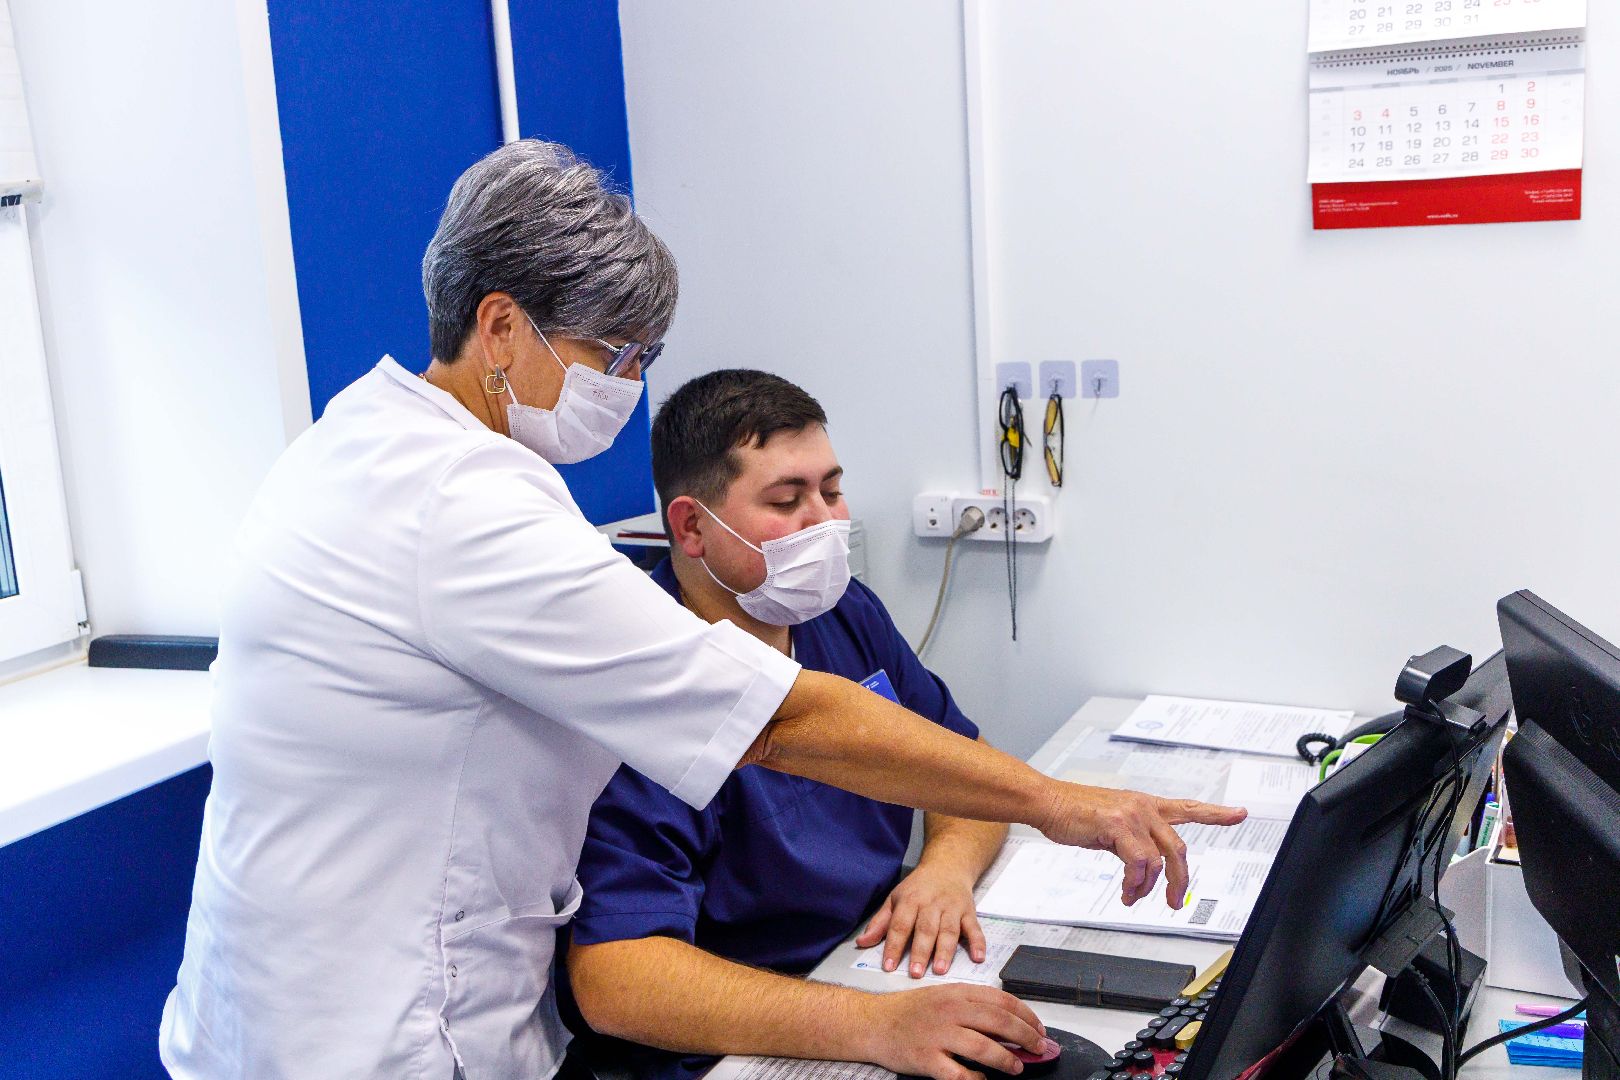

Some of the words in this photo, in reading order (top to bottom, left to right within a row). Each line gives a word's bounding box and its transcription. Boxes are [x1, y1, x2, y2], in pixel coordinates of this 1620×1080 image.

[1349, 8, 1366, 20] 20
[1377, 6, 1392, 17] 21
[1406, 3, 1422, 15] 22
[1434, 0, 1452, 12] 23
[1348, 25, 1365, 36] 27
[1377, 22, 1393, 33] 28
[1405, 20, 1422, 30] 29
[1434, 17, 1451, 27] 30
[1464, 14, 1479, 25] 31
[1387, 67, 1419, 76] НОЯБРЬ
[1434, 65, 1453, 73] 2025
[1467, 60, 1514, 70] NOVEMBER
[1498, 83, 1504, 94] 1
[1527, 81, 1536, 92] 2
[1353, 110, 1362, 121] 3
[1382, 108, 1390, 118] 4
[1409, 106, 1418, 117] 5
[1438, 104, 1447, 115] 6
[1467, 102, 1476, 112] 7
[1497, 100, 1505, 111] 8
[1526, 98, 1535, 109] 9
[1350, 126, 1366, 137] 10
[1379, 124, 1392, 135] 11
[1407, 122, 1422, 133] 12
[1435, 120, 1451, 131] 13
[1464, 118, 1479, 129] 14
[1493, 116, 1510, 128] 15
[1523, 114, 1539, 125] 16
[1350, 142, 1365, 153] 17
[1378, 140, 1393, 151] 18
[1407, 138, 1422, 149] 19
[1433, 137, 1451, 148] 20
[1462, 135, 1478, 146] 21
[1491, 133, 1509, 144] 22
[1521, 131, 1539, 142] 23
[1348, 158, 1364, 168] 24
[1376, 156, 1392, 168] 25
[1404, 154, 1421, 165] 26
[1432, 152, 1449, 164] 27
[1462, 151, 1479, 162] 28
[1490, 149, 1508, 160] 29
[1521, 147, 1539, 159] 30
